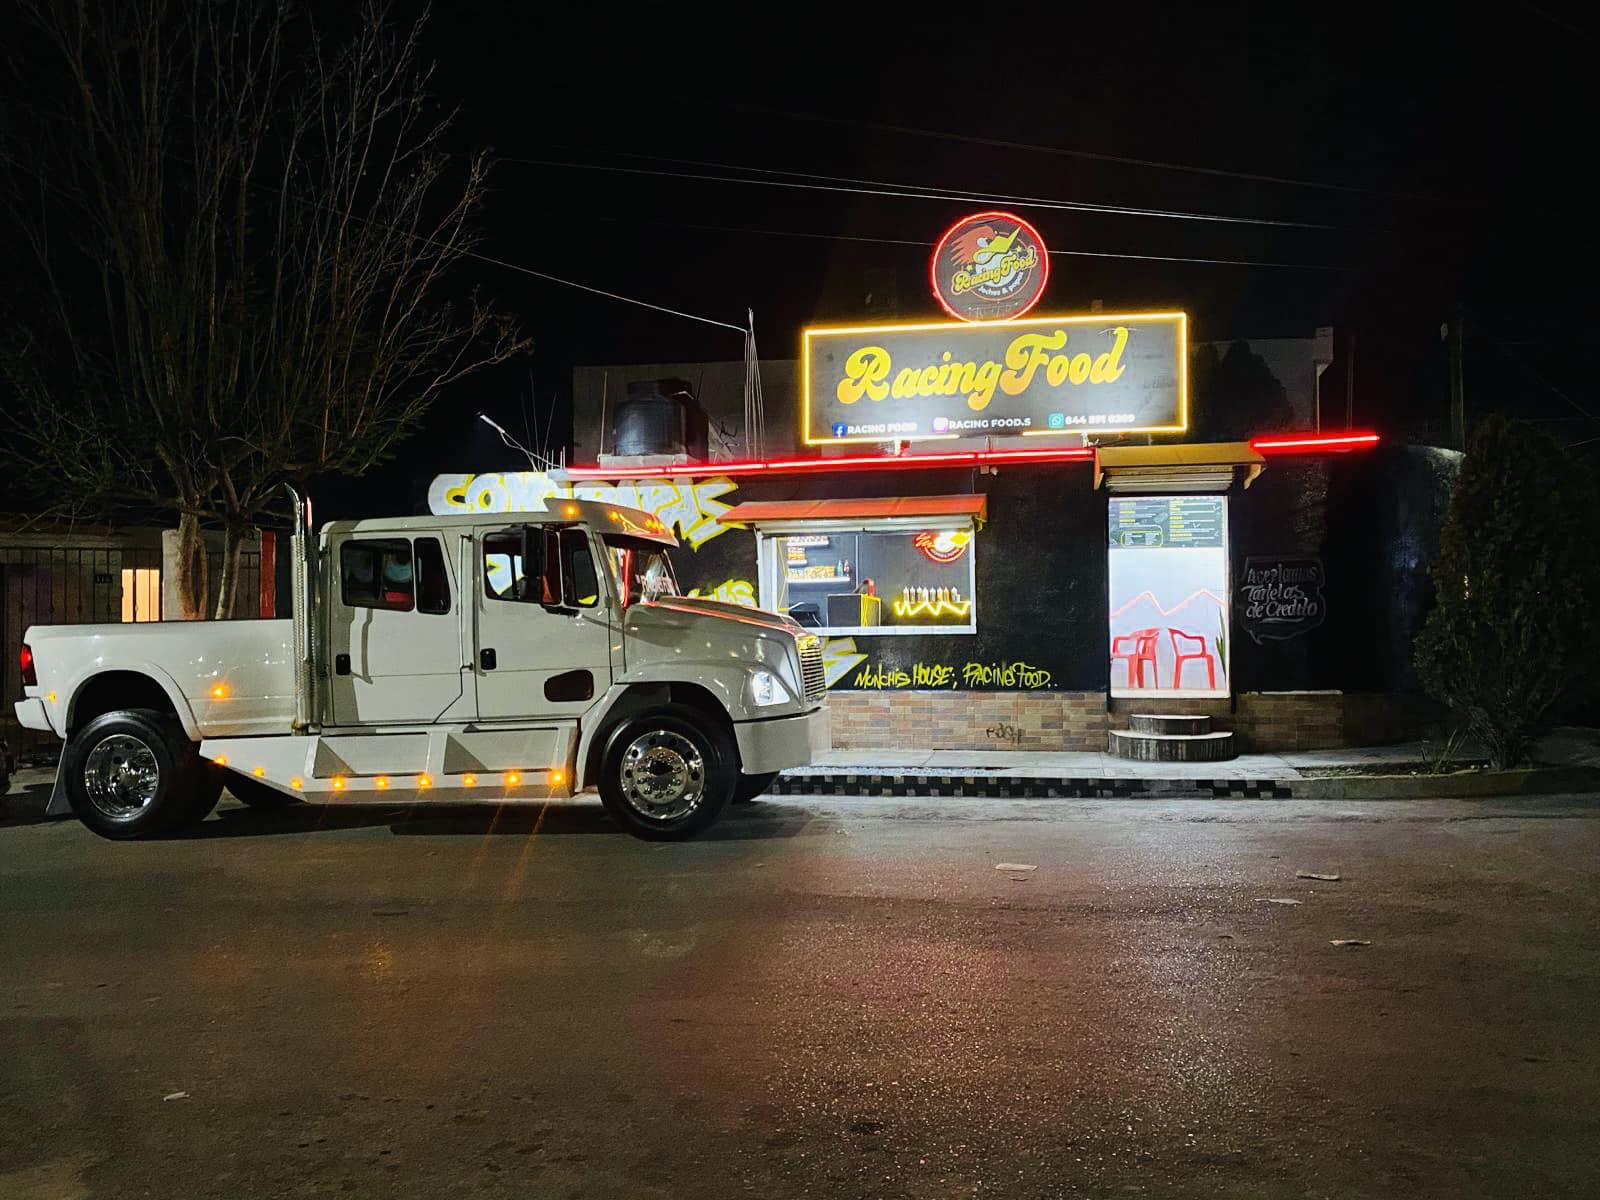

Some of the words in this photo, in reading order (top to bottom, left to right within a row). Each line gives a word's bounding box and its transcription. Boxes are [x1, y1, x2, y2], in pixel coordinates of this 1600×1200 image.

[837, 346, 1001, 411] Racing
[1000, 326, 1129, 396] Food
[847, 423, 886, 434] RACING
[949, 418, 989, 429] RACING
[991, 417, 1031, 428] FOOD.S
[1246, 601, 1263, 618] de
